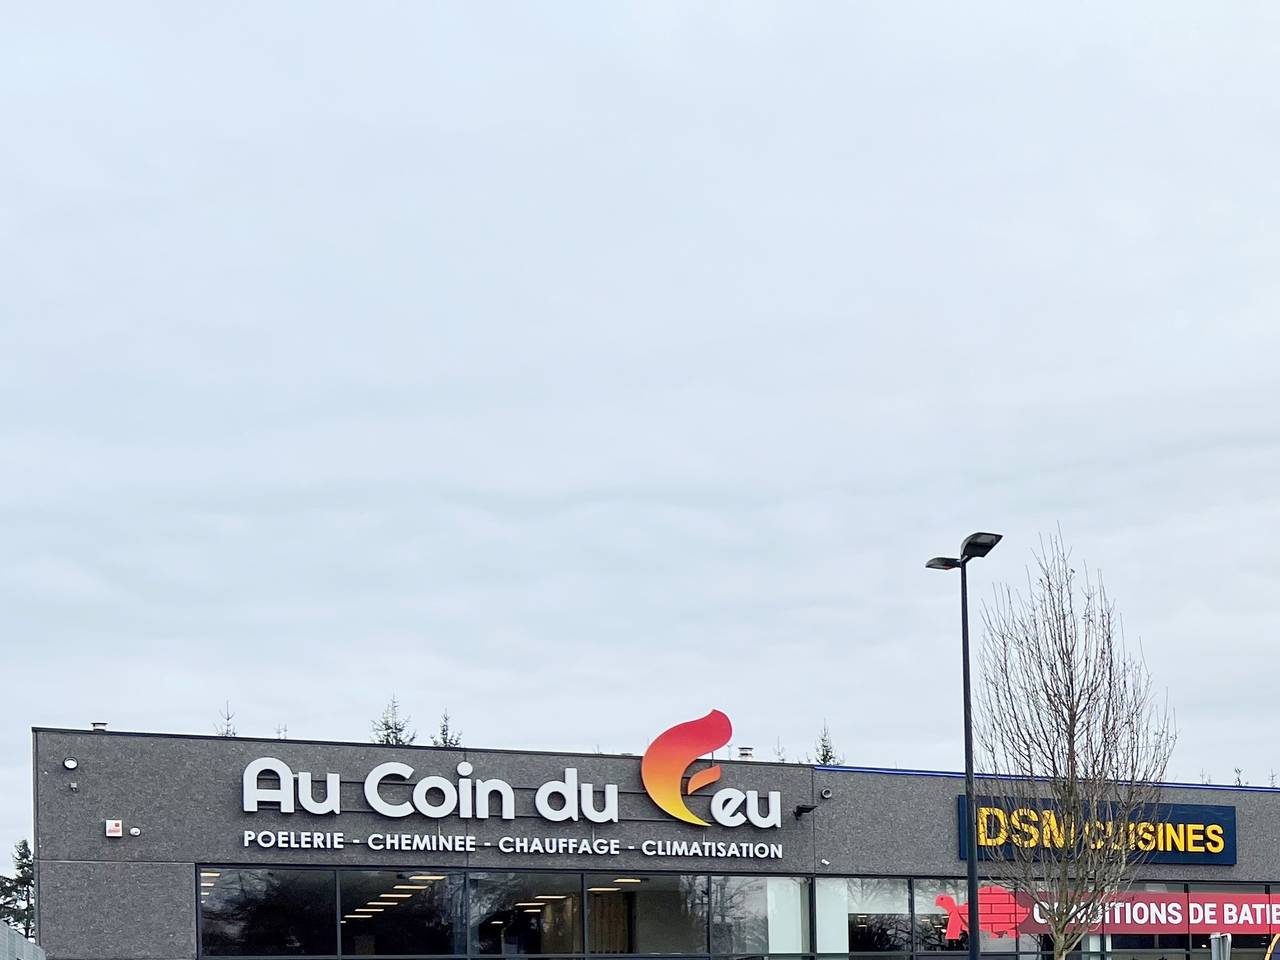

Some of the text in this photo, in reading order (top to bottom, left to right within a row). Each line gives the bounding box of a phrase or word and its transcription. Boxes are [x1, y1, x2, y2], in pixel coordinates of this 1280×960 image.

[243, 757, 340, 815] Au
[364, 761, 515, 819] Coin
[535, 768, 618, 823] du
[244, 830, 344, 849] POELERIE
[367, 833, 476, 852] CHEMINEE
[499, 836, 620, 855] CHAUFFAGE
[641, 840, 783, 859] CLIMATISATION
[1033, 902, 1183, 925] CNITIONS
[1189, 902, 1217, 925] DE
